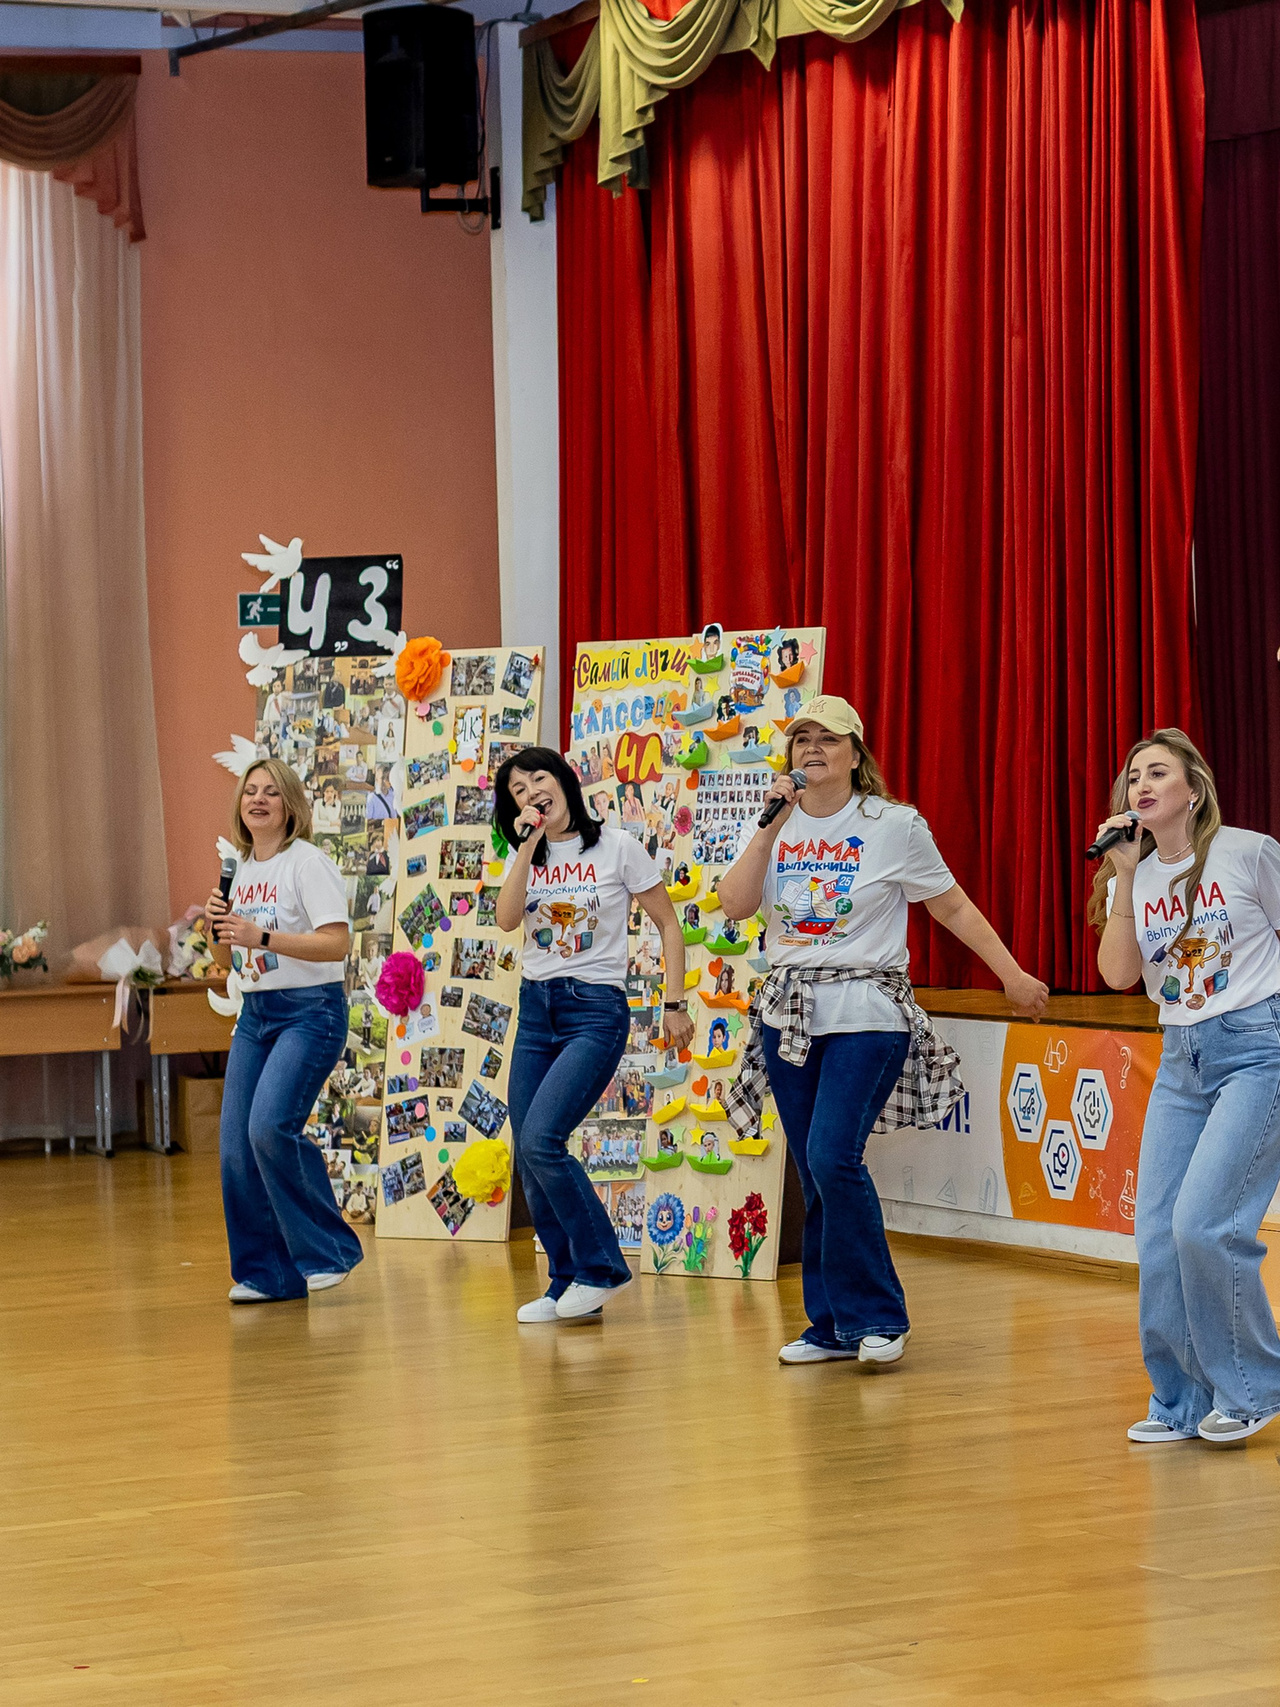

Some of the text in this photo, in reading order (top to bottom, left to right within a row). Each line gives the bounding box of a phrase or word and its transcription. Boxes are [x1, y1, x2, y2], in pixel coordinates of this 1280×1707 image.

[777, 838, 860, 862] МАМА
[531, 862, 597, 887] МАМА
[777, 861, 860, 873] ВЫПУСКНИЦЫ
[839, 876, 851, 887] 25
